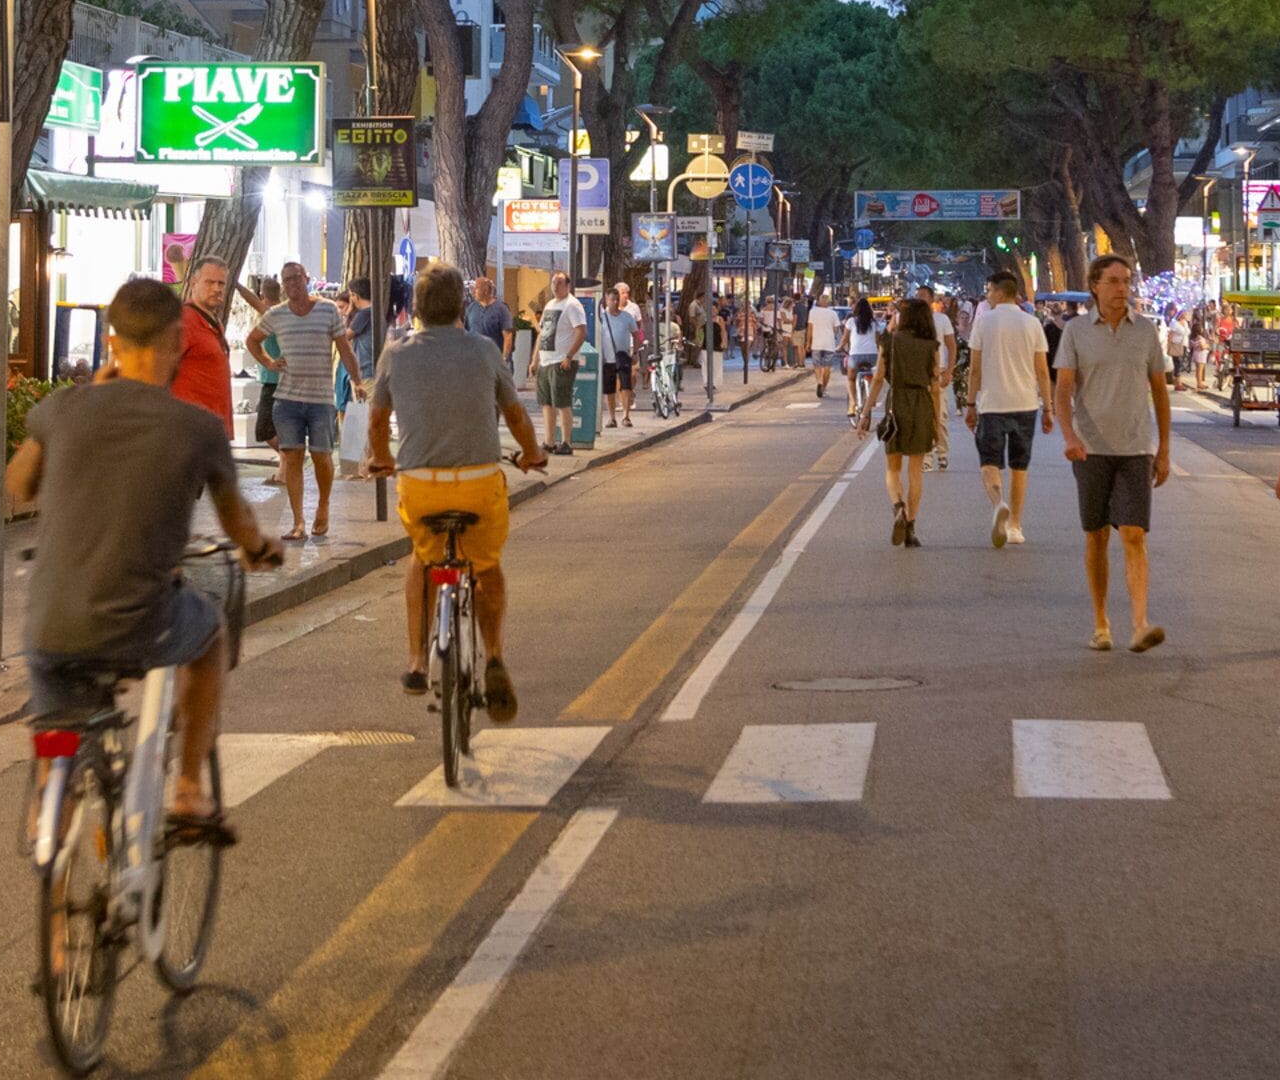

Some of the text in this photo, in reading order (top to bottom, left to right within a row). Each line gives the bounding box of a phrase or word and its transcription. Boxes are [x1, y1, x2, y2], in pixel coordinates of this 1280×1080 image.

[164, 67, 295, 102] PIAVE
[338, 129, 407, 143] EGITTO
[511, 201, 559, 210] HOTEL
